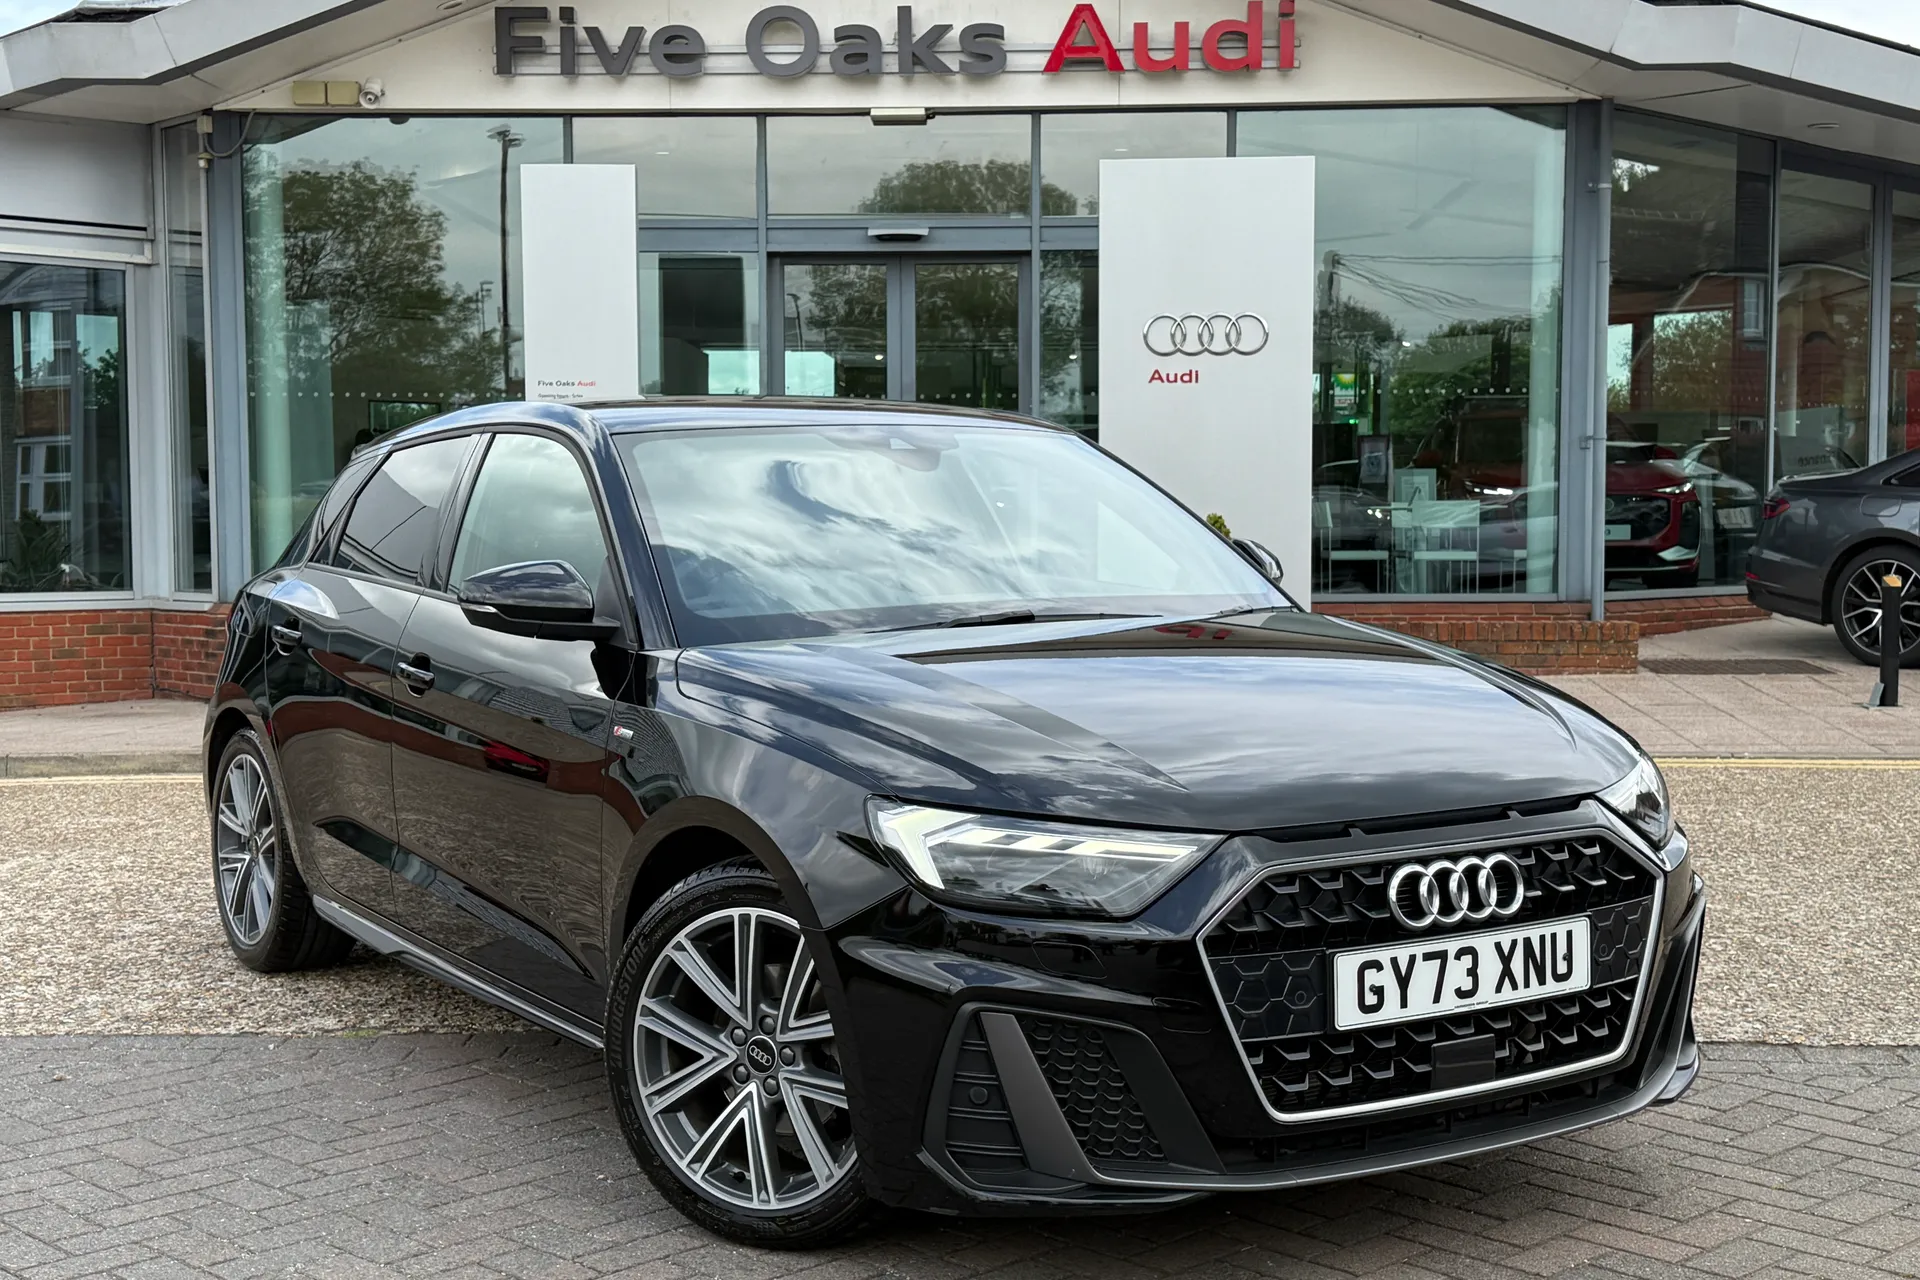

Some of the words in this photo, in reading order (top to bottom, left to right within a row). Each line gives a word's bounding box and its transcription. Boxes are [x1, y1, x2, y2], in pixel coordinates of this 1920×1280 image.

[494, 6, 706, 77] Five
[745, 4, 1007, 77] Oaks
[1042, 0, 1296, 73] Audi
[1148, 369, 1199, 383] Audi
[1356, 945, 1480, 1015] GY73
[1494, 929, 1573, 994] XNU
